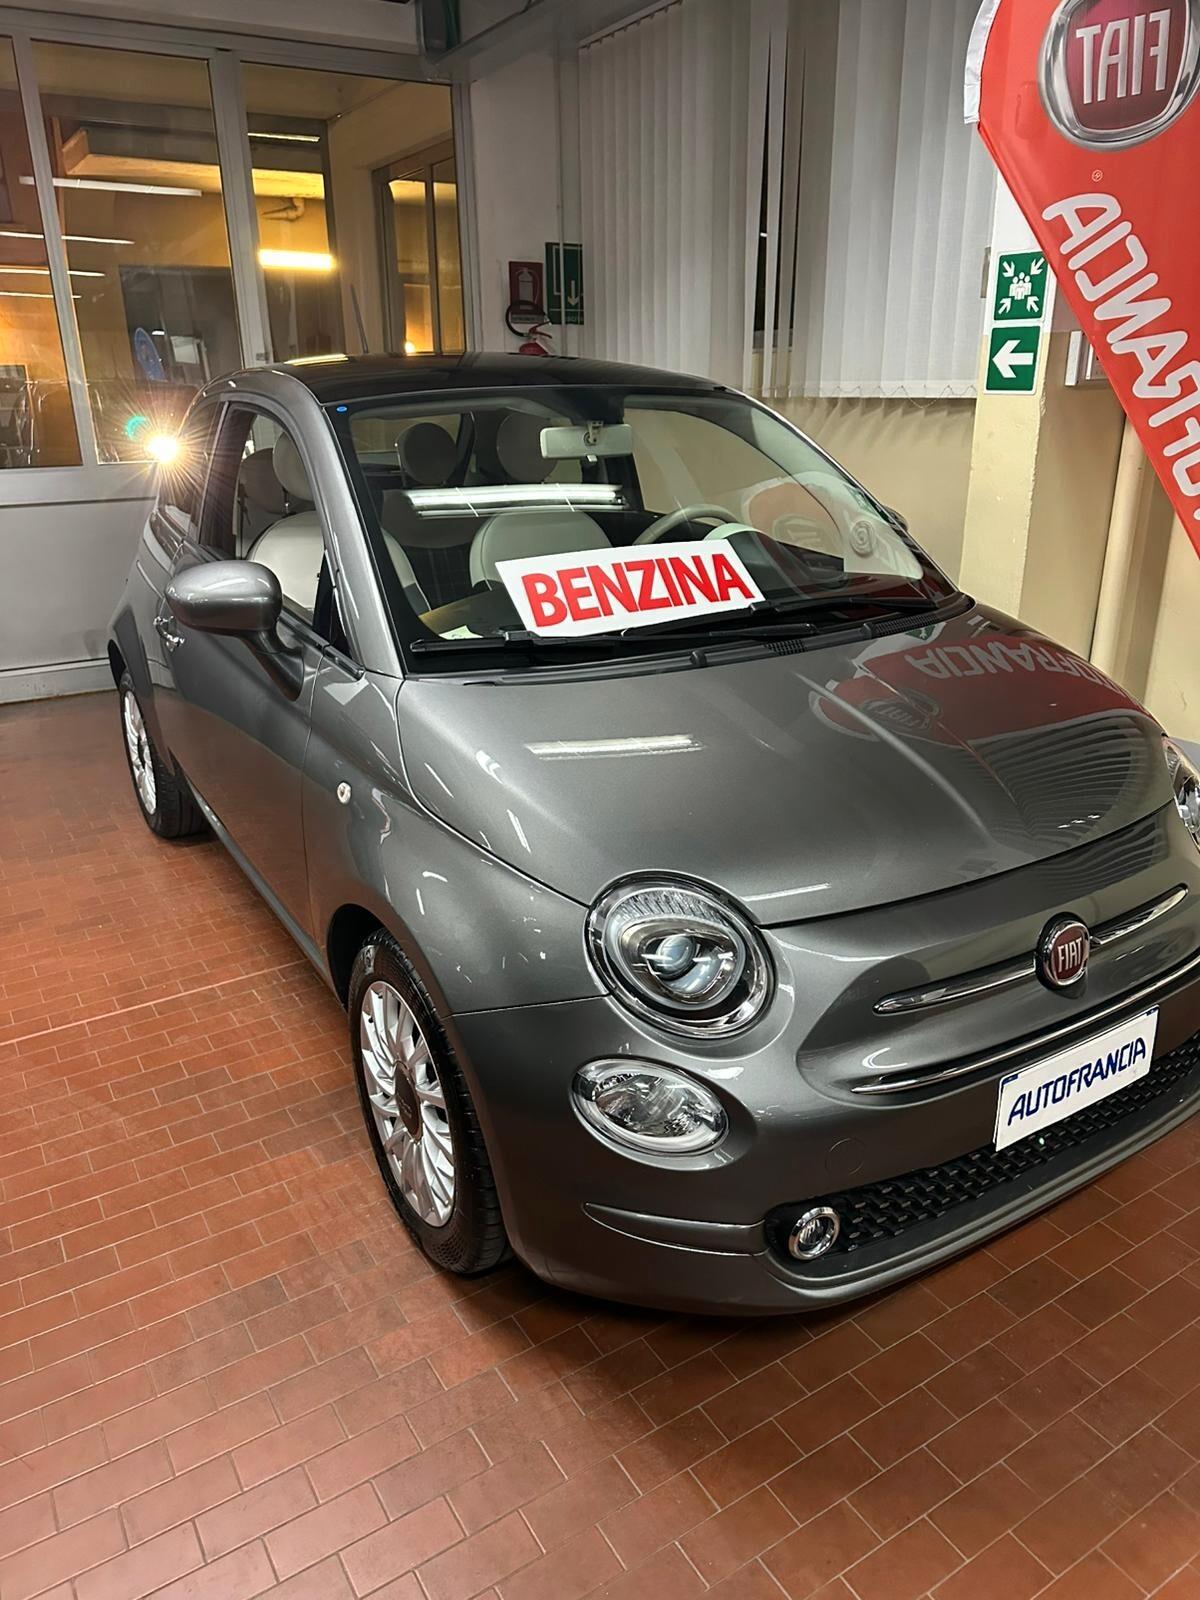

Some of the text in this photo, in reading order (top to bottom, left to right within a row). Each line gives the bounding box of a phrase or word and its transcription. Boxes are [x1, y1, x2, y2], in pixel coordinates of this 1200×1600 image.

[521, 553, 756, 628] BENZINA
[1057, 937, 1083, 973] FIAT
[1007, 1036, 1147, 1127] AUTOFRANCIA
